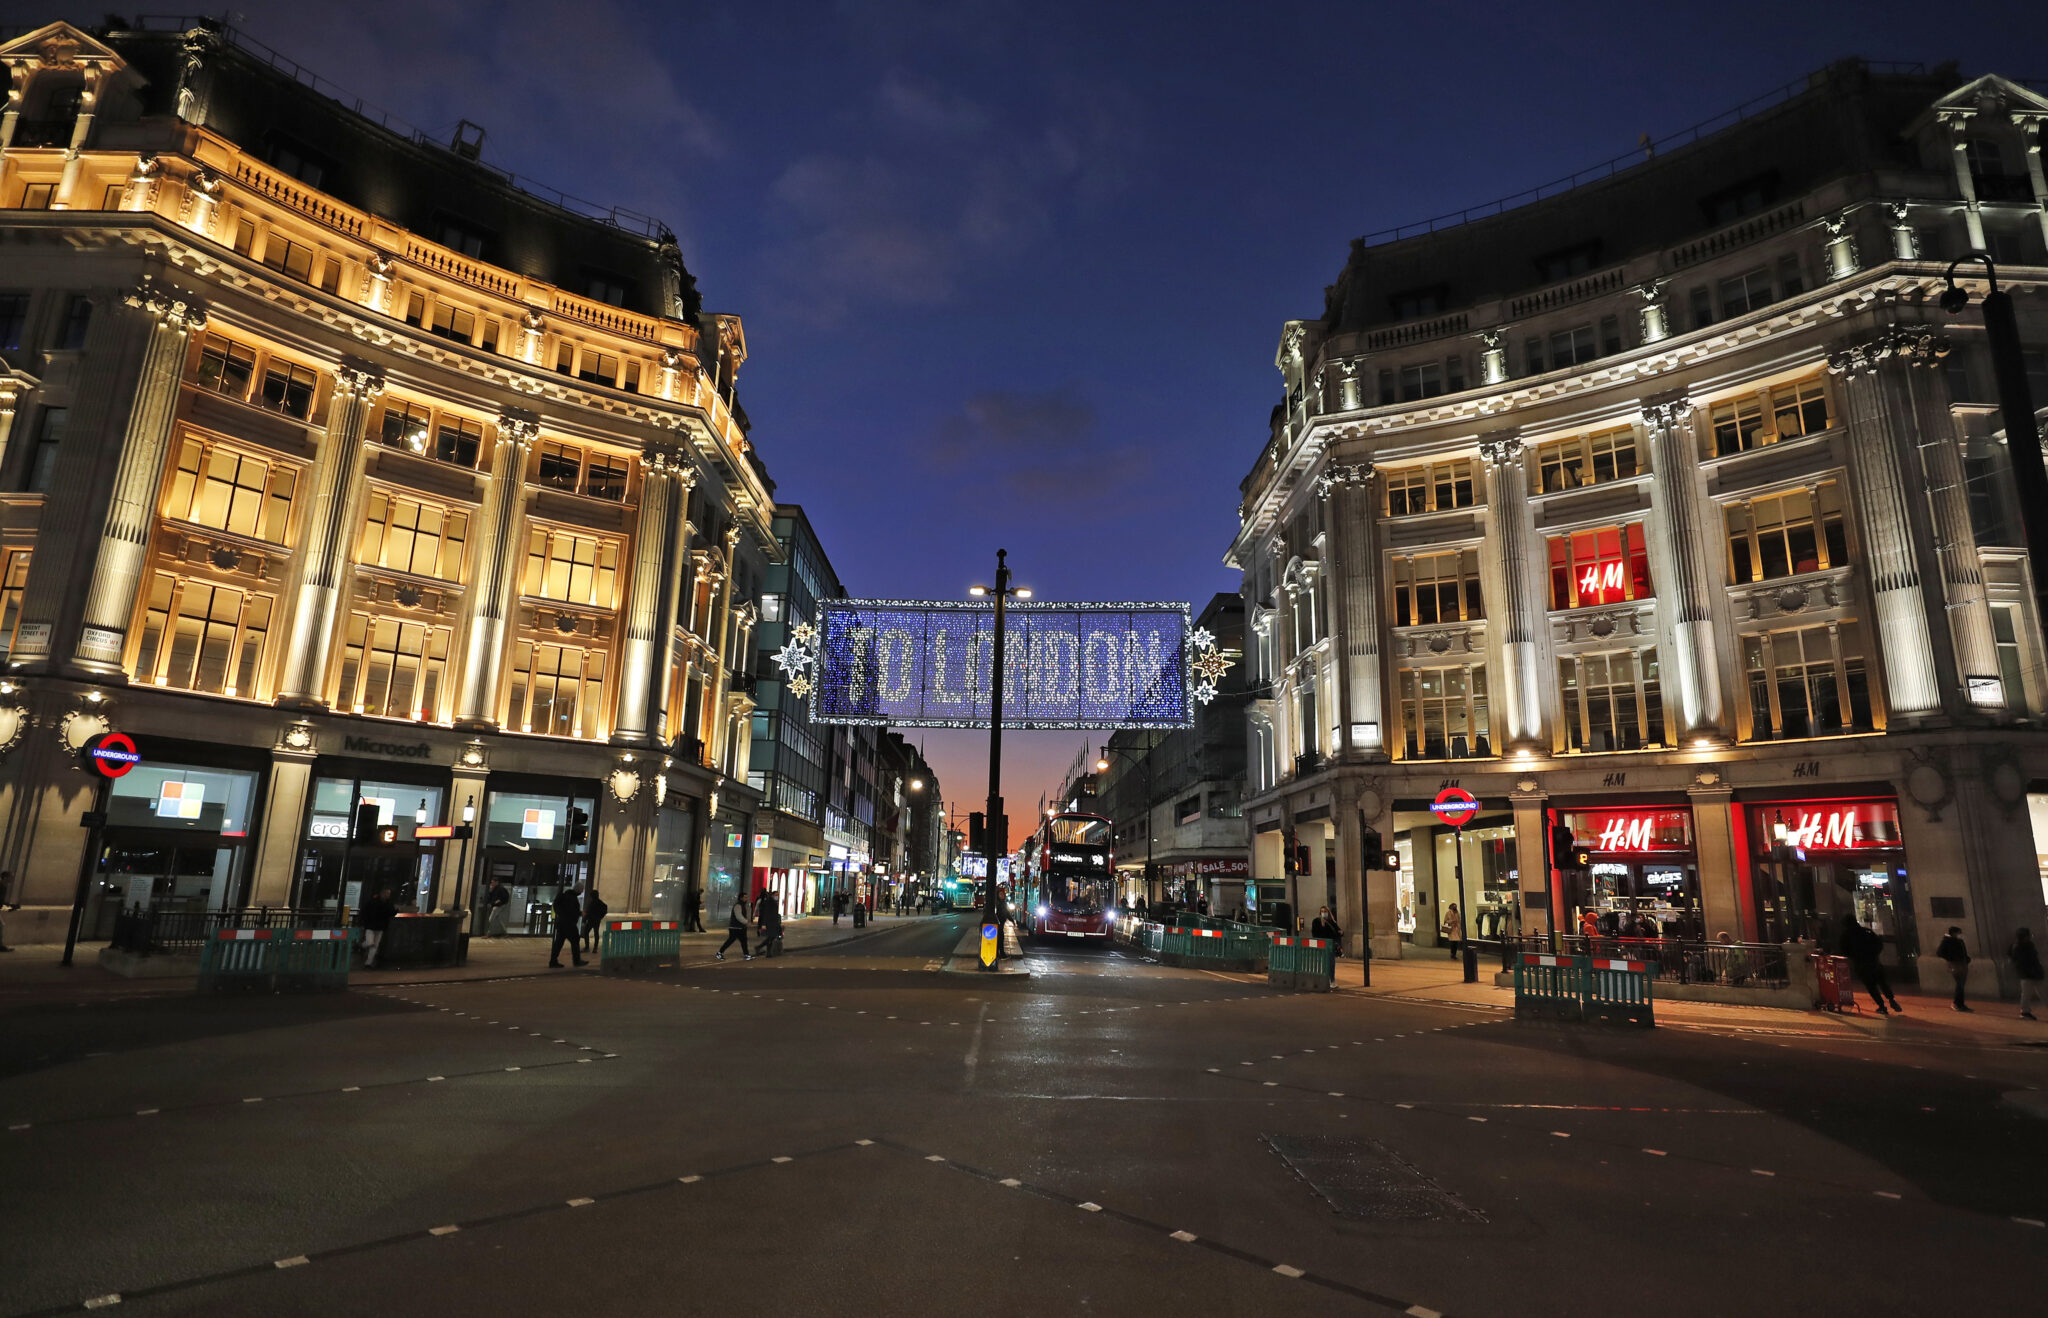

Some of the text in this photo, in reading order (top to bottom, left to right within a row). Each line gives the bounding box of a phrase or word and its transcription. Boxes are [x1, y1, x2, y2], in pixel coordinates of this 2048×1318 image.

[86, 635, 108, 644] CIRCUS
[87, 630, 111, 639] OXFORD
[845, 627, 1162, 704] TO LONDON
[344, 736, 431, 758] Microsoft
[93, 749, 139, 761] UNDERGROUND
[1602, 773, 1626, 787] H&M
[1599, 818, 1652, 851] H&M
[1797, 811, 1855, 848] H&M
[1057, 854, 1083, 863] Holborn
[1091, 854, 1104, 866] 98
[1203, 861, 1226, 873] SALE
